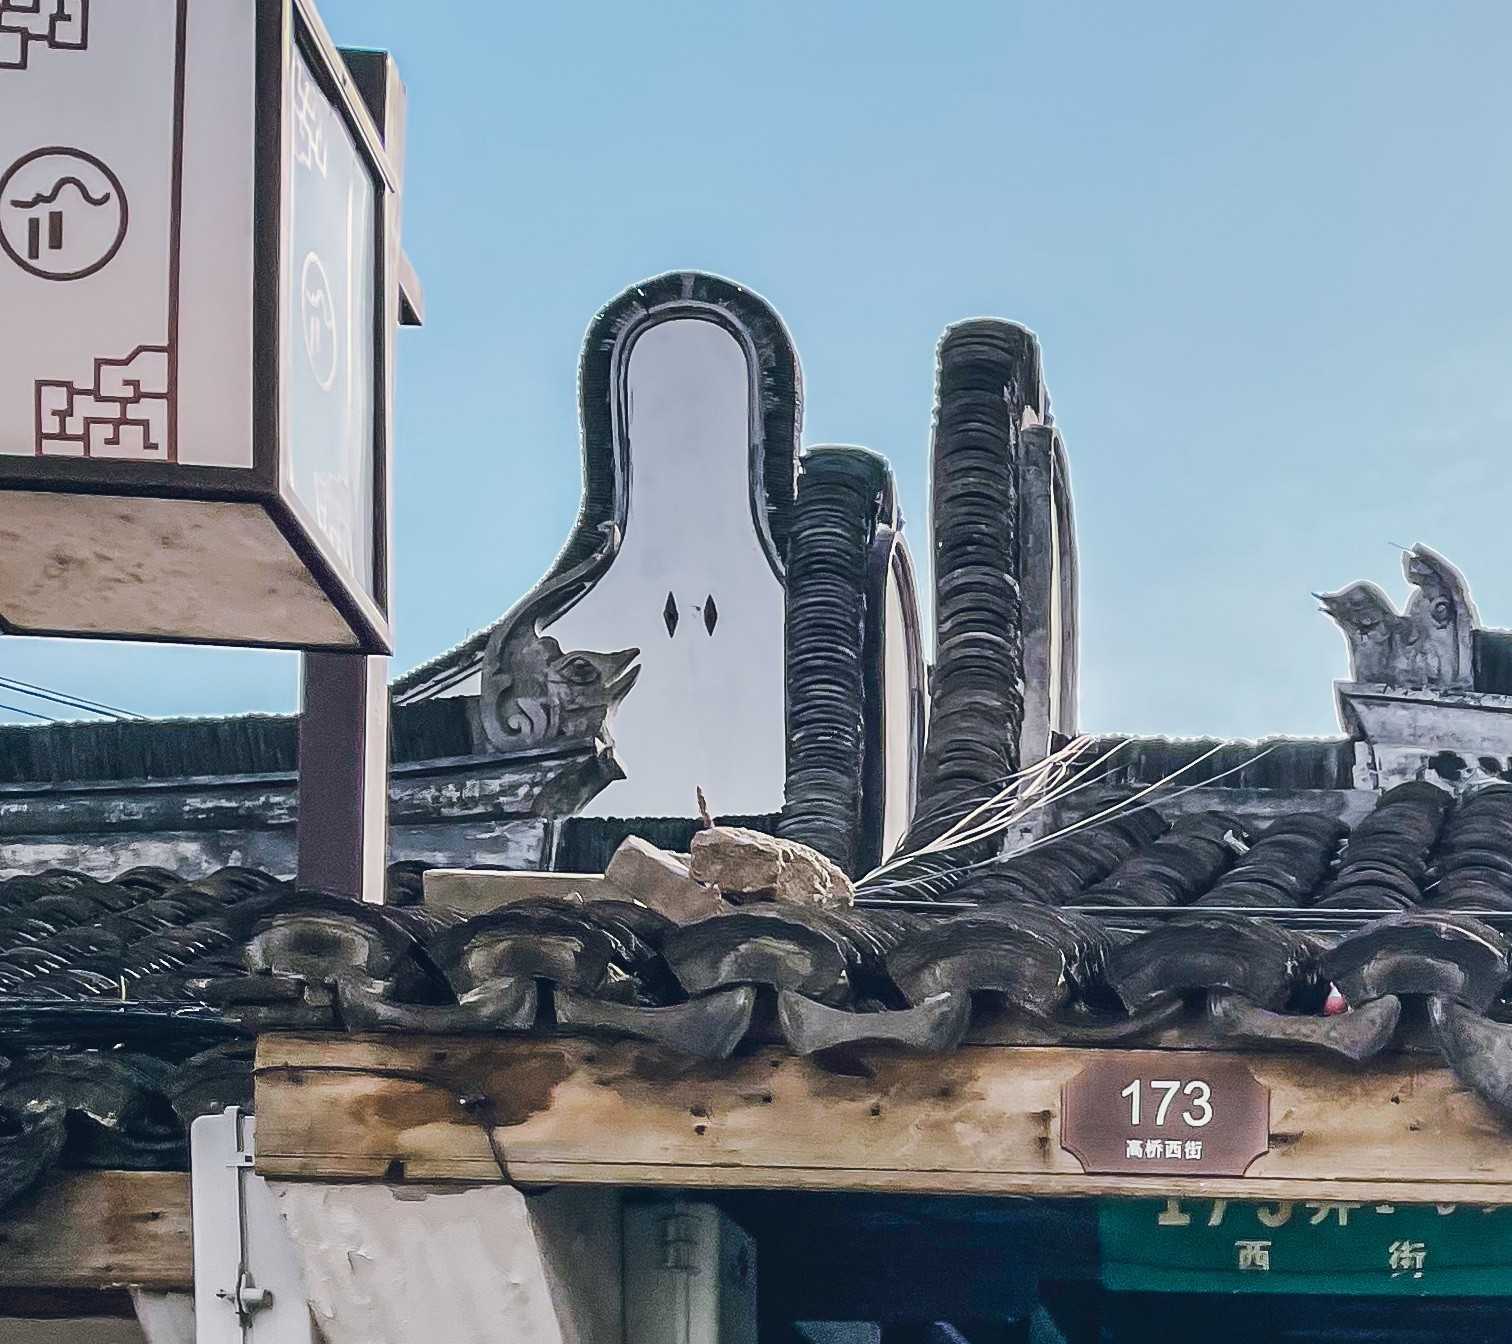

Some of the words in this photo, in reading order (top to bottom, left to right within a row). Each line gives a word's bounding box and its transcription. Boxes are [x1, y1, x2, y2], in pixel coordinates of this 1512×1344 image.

[1120, 1078, 1214, 1128] 173
[1125, 1138, 1204, 1160] 高桥西街
